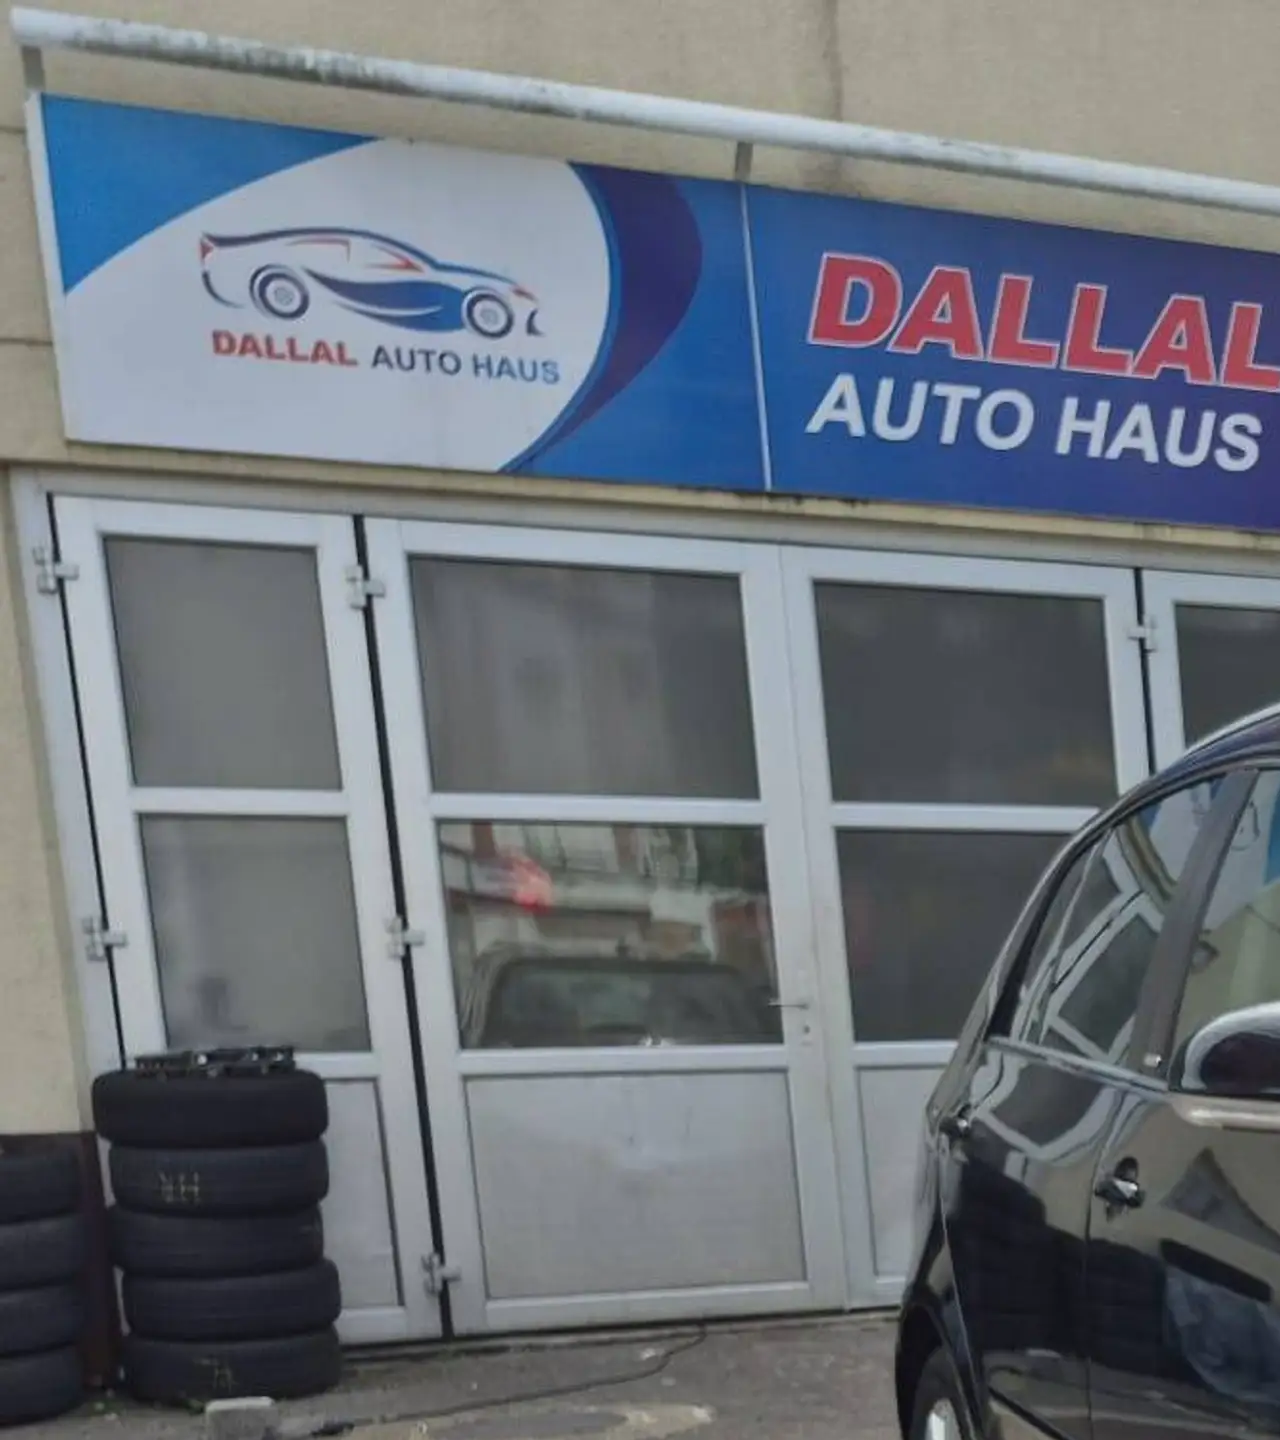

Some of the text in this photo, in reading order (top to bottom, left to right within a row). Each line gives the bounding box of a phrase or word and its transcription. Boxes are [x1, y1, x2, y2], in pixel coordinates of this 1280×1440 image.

[211, 329, 561, 385] DALLAL AUTO HAUS
[805, 373, 1263, 472] AUTO HAUS
